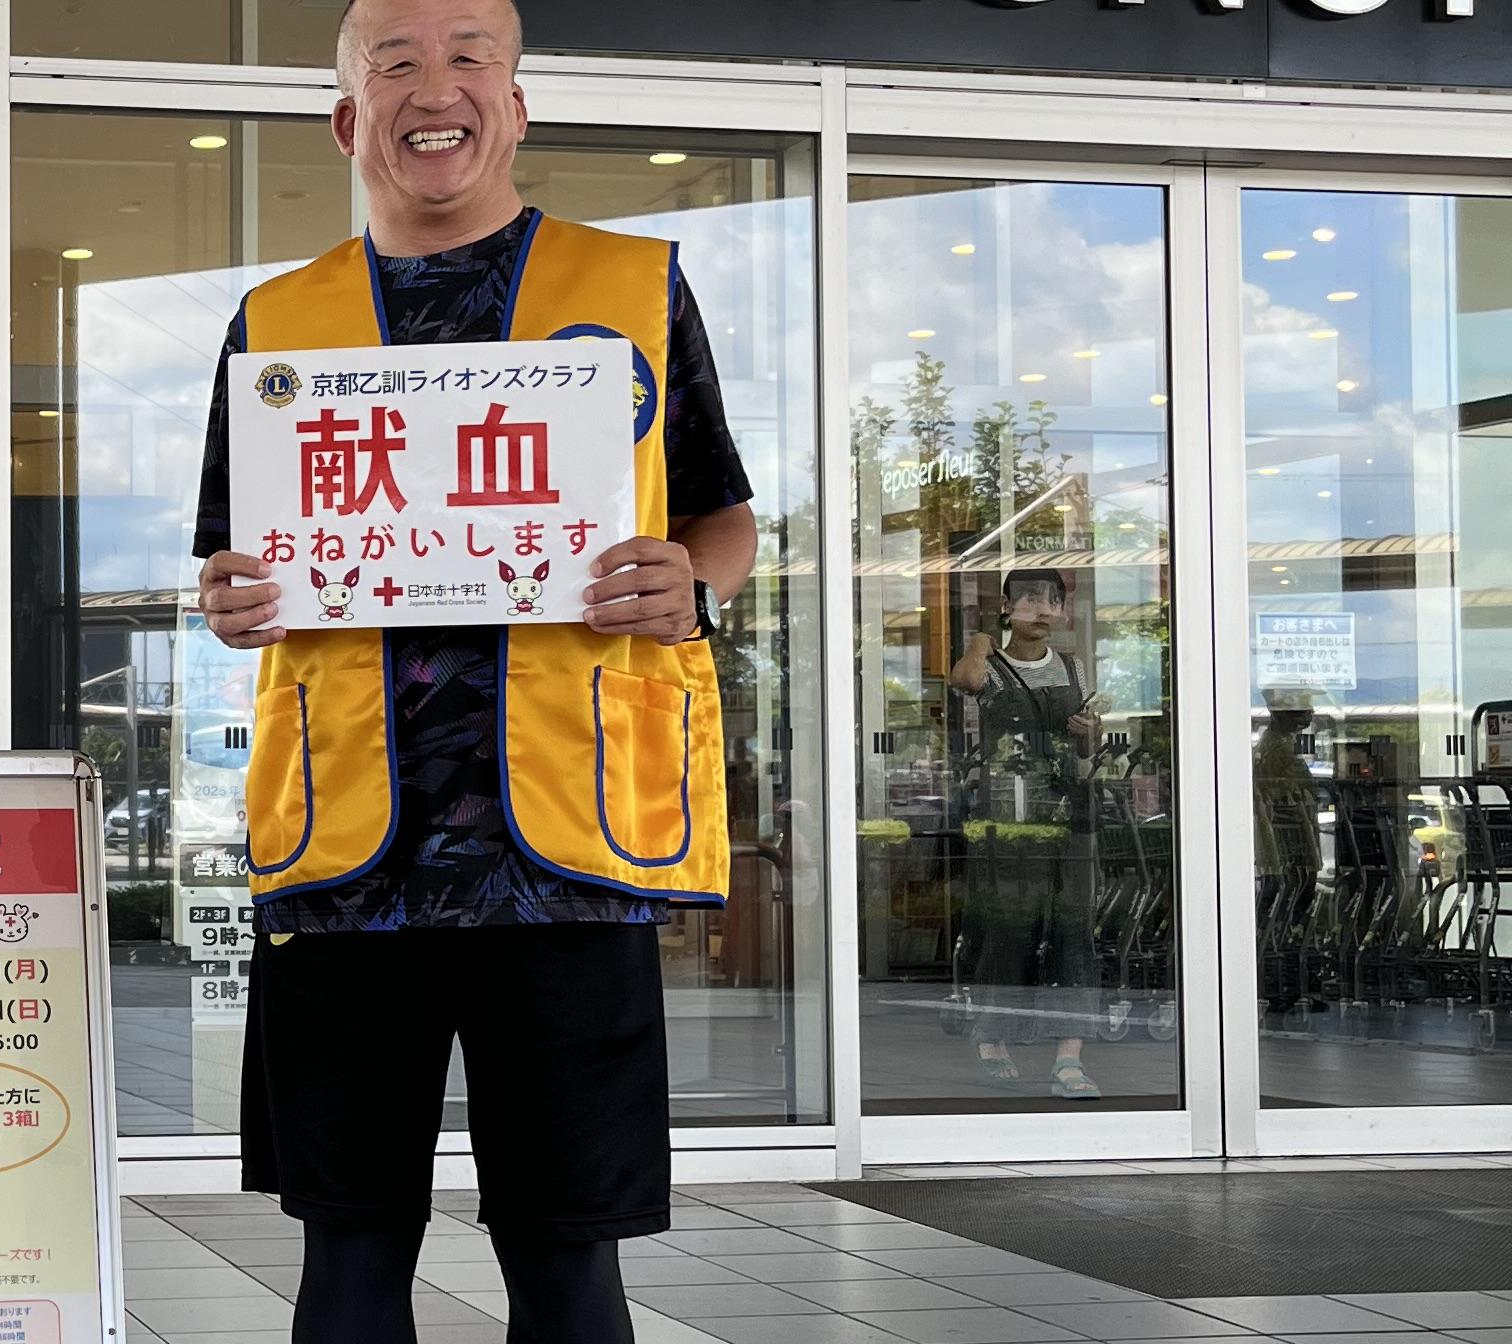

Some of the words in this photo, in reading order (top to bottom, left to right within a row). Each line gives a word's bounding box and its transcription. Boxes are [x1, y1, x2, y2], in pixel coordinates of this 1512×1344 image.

[311, 363, 600, 398] 京都乙訓ライオンズクラブ
[296, 402, 561, 518] 献血
[261, 518, 599, 564] おねがいします
[407, 582, 488, 599] 日本赤十字社
[1272, 617, 1338, 633] お客さまへ
[1273, 648, 1339, 660] 危険ですので
[200, 963, 217, 974] 1F
